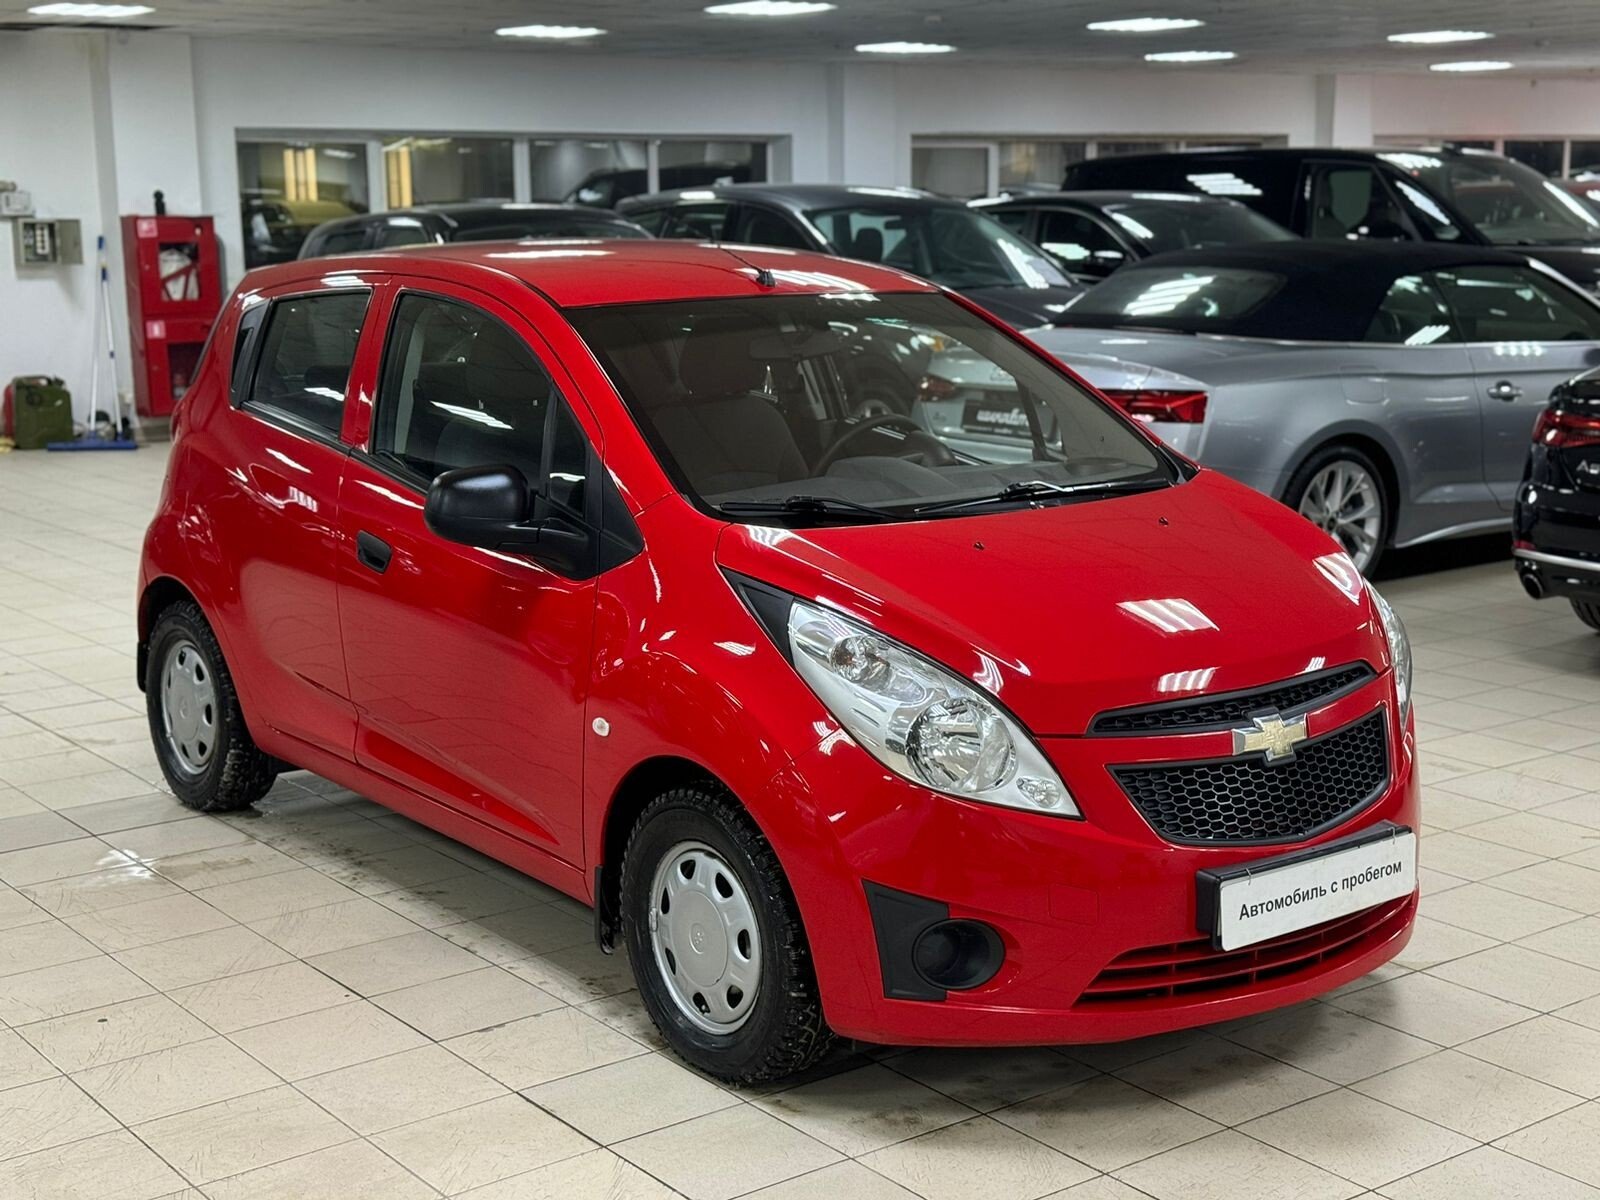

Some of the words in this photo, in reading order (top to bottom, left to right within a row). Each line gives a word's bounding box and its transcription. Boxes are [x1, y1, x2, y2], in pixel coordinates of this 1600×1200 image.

[1239, 885, 1327, 920] Автомобиль
[1330, 881, 1338, 893] с
[1341, 861, 1402, 891] пробегом
